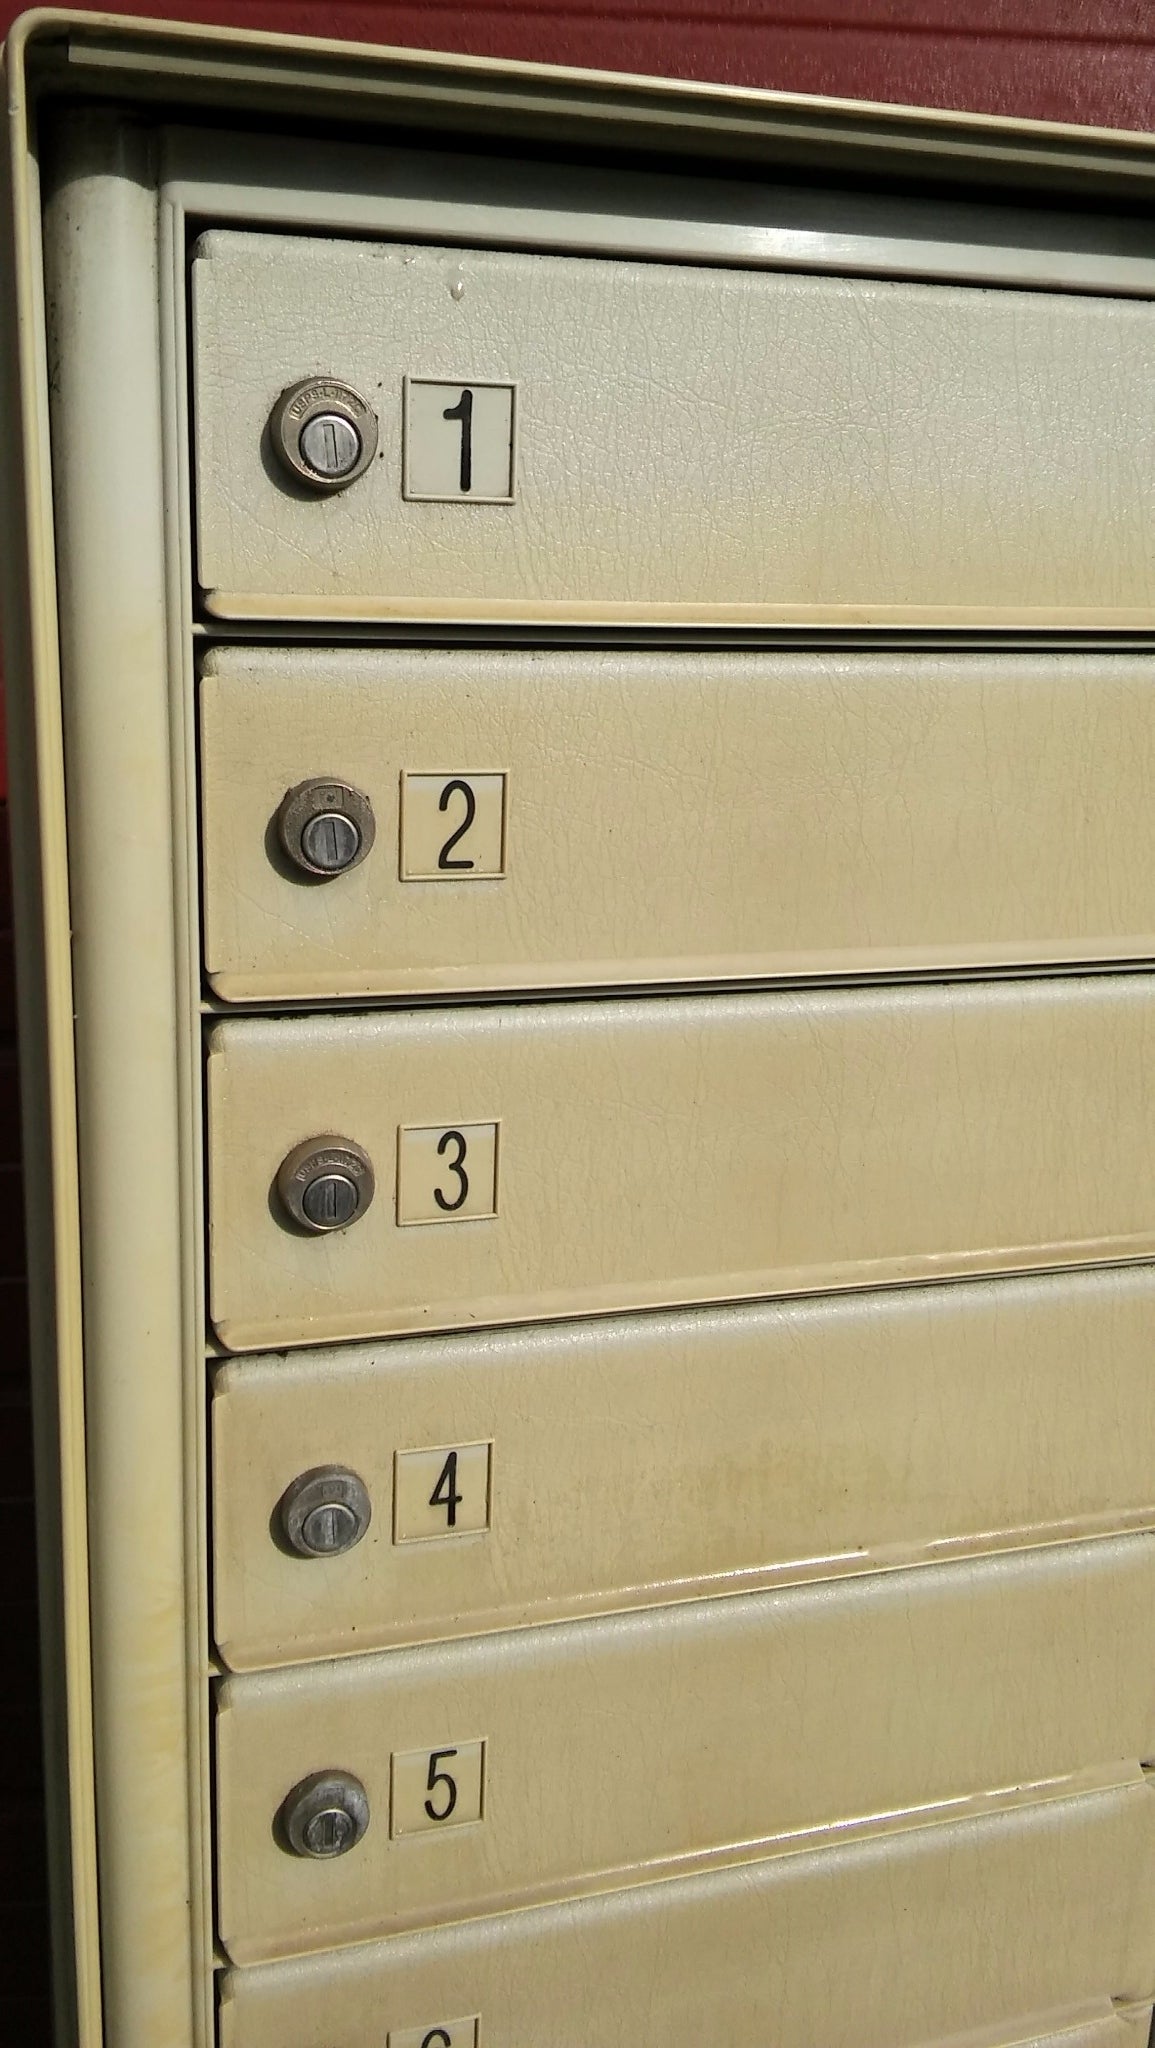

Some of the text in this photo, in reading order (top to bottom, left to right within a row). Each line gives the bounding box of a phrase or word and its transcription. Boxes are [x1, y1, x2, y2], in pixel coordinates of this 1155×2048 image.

[443, 388, 472, 492] 1
[438, 779, 476, 870] 2
[433, 1130, 469, 1212] 3
[428, 1451, 463, 1527] 4
[424, 1749, 458, 1821] 5
